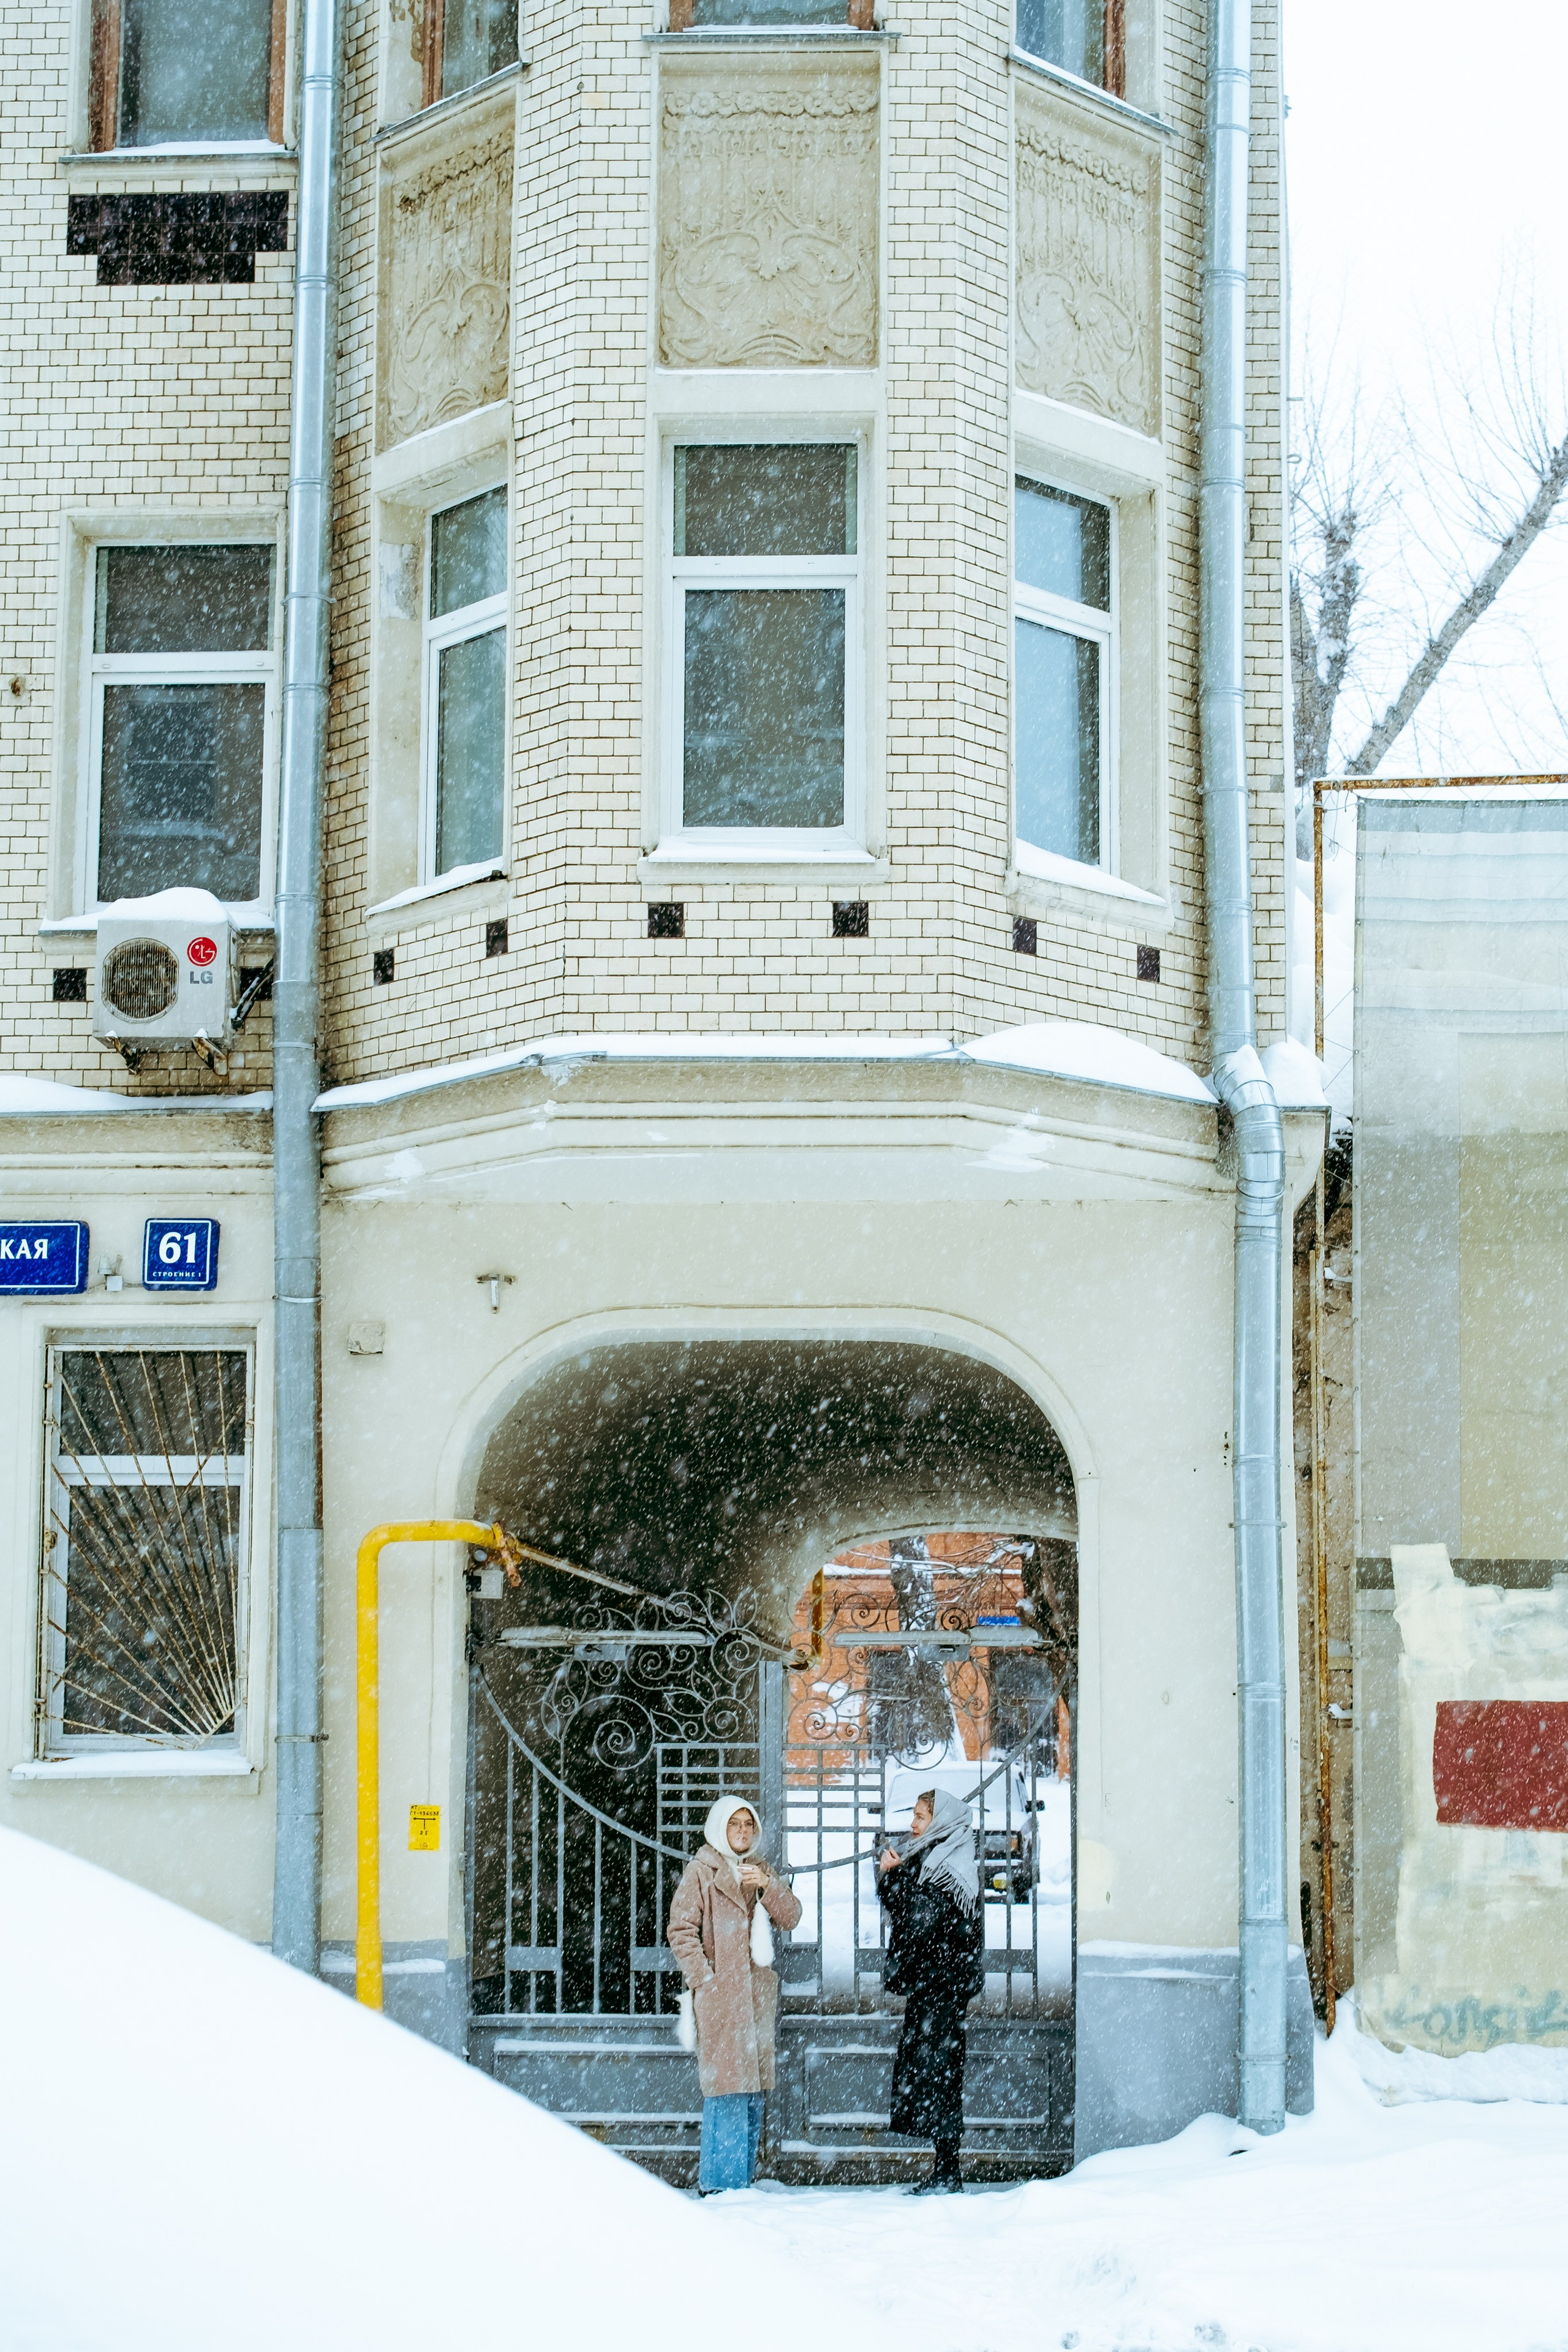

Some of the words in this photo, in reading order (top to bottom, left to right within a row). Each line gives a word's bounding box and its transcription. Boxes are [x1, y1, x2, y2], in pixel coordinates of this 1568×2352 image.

[190, 970, 213, 984] LG
[0, 1238, 48, 1259] КАЯ
[159, 1232, 196, 1264] 61
